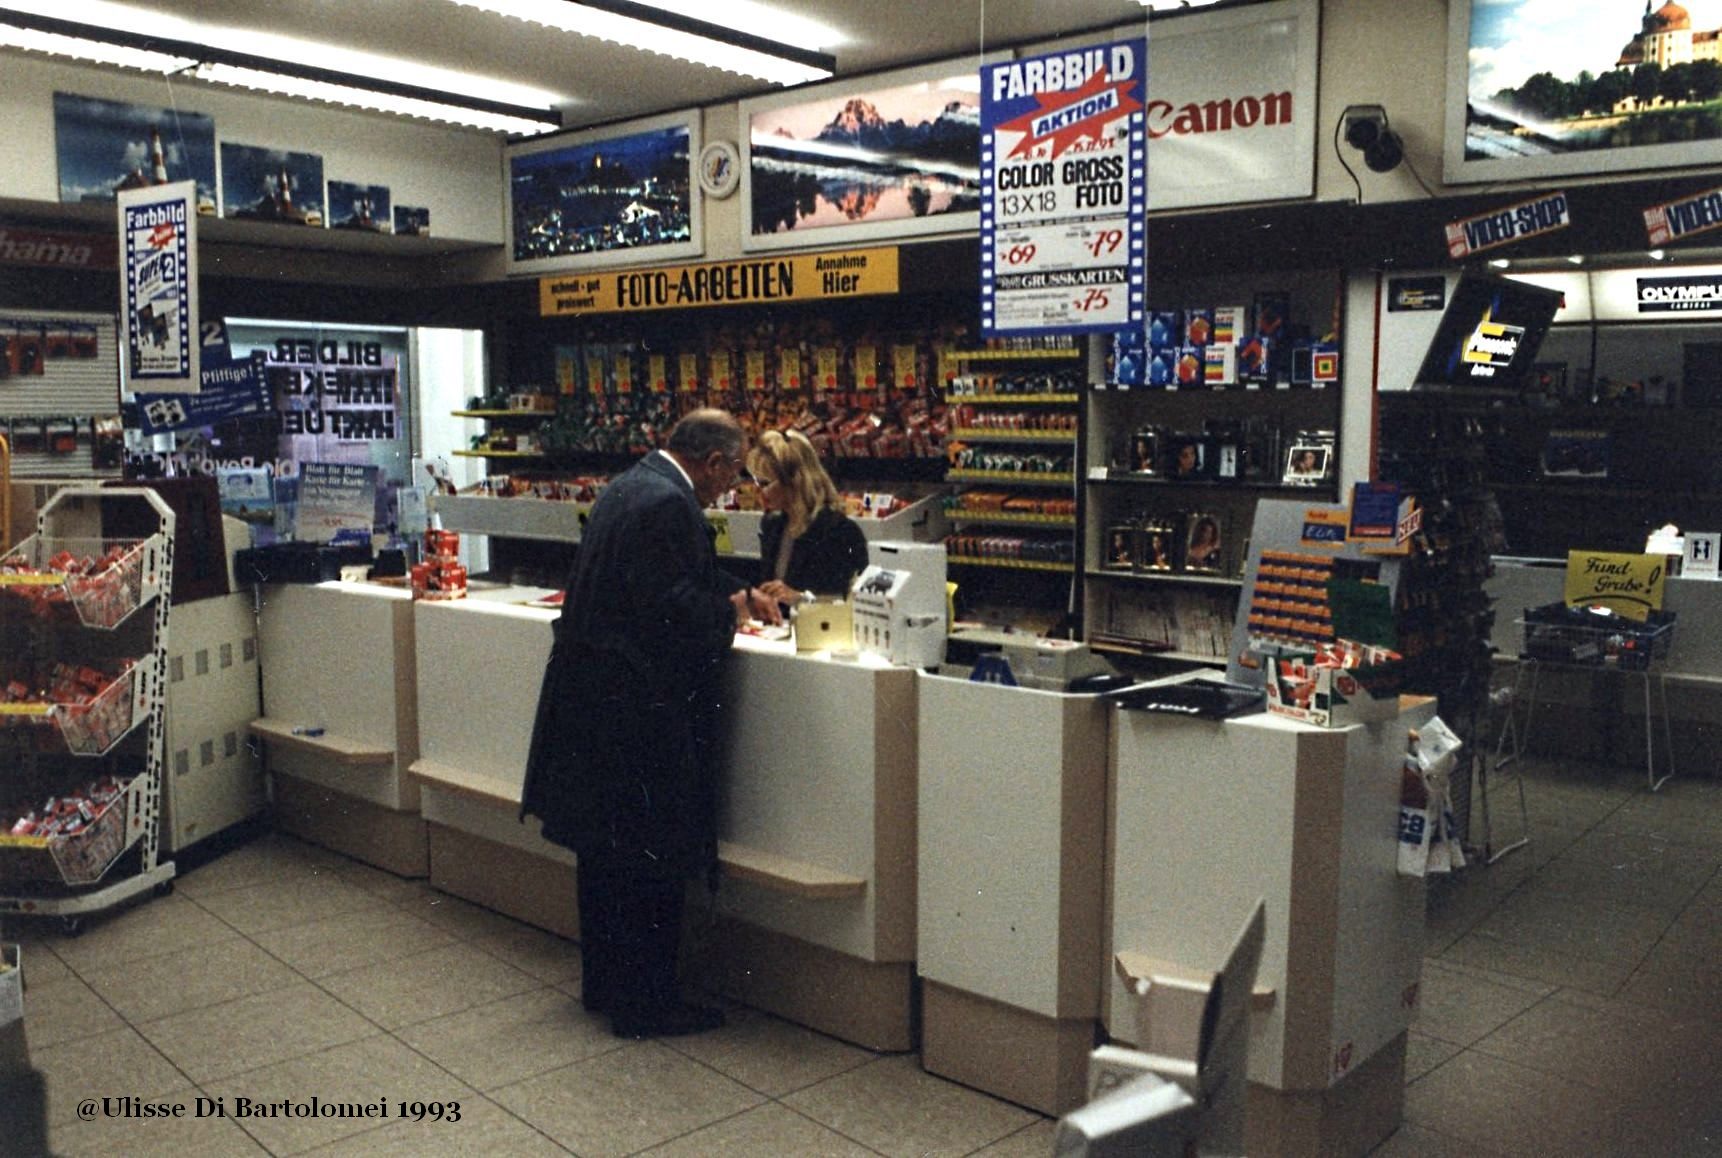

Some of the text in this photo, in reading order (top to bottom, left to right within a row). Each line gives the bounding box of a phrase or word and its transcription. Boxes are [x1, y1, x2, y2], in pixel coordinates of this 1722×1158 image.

[993, 46, 1134, 101] FARBBILD
[1036, 93, 1112, 136] AKTION
[1147, 91, 1293, 139] Canon
[999, 155, 1123, 190] COLOR GROSS
[1076, 182, 1123, 208] FOTO
[127, 203, 184, 228] Farbbild
[1466, 197, 1568, 249] VIDEO-SHOP
[815, 255, 867, 272] Annahme
[1021, 269, 1125, 288] GRUSSKARTEN
[617, 261, 794, 308] FOTO-ARBEITEN
[823, 271, 860, 294] Hier
